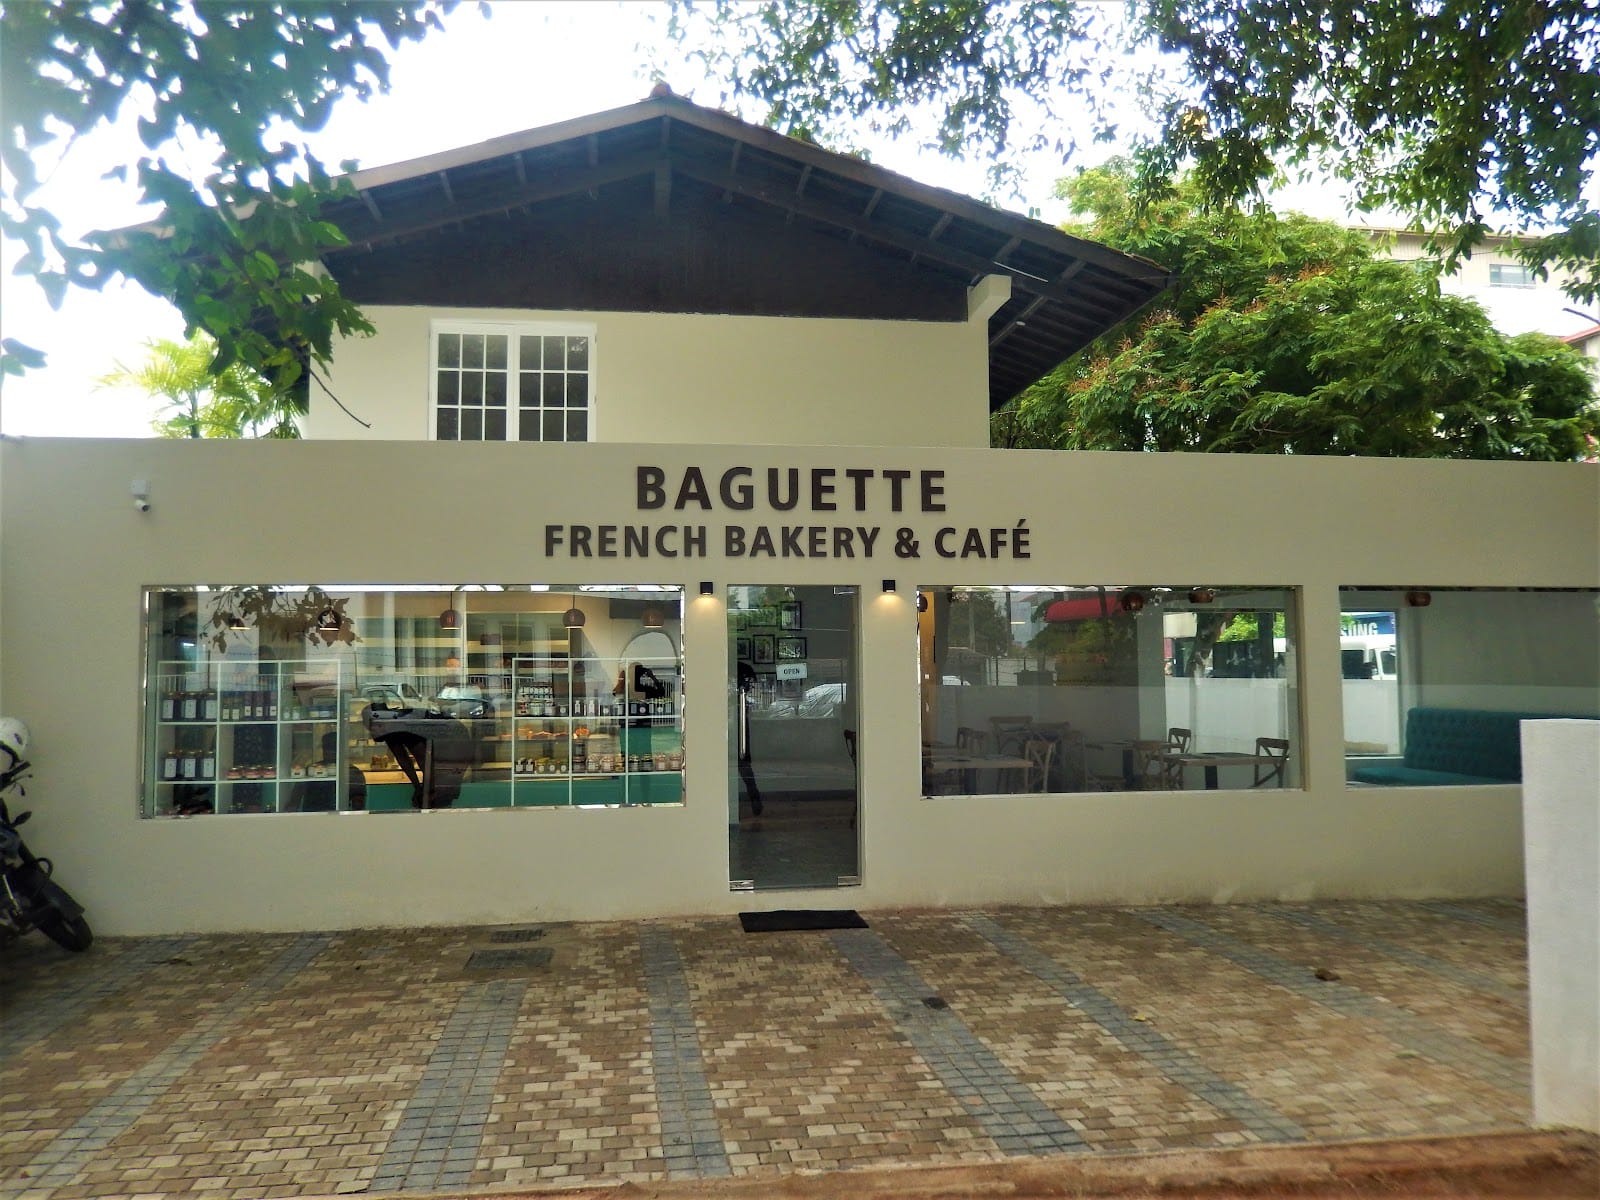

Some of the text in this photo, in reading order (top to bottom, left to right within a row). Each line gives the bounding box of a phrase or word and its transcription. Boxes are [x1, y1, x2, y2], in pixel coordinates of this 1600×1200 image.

[636, 465, 947, 513] BAGUETTE
[545, 518, 1031, 559] FRENCH BAKERY & CAFÉ
